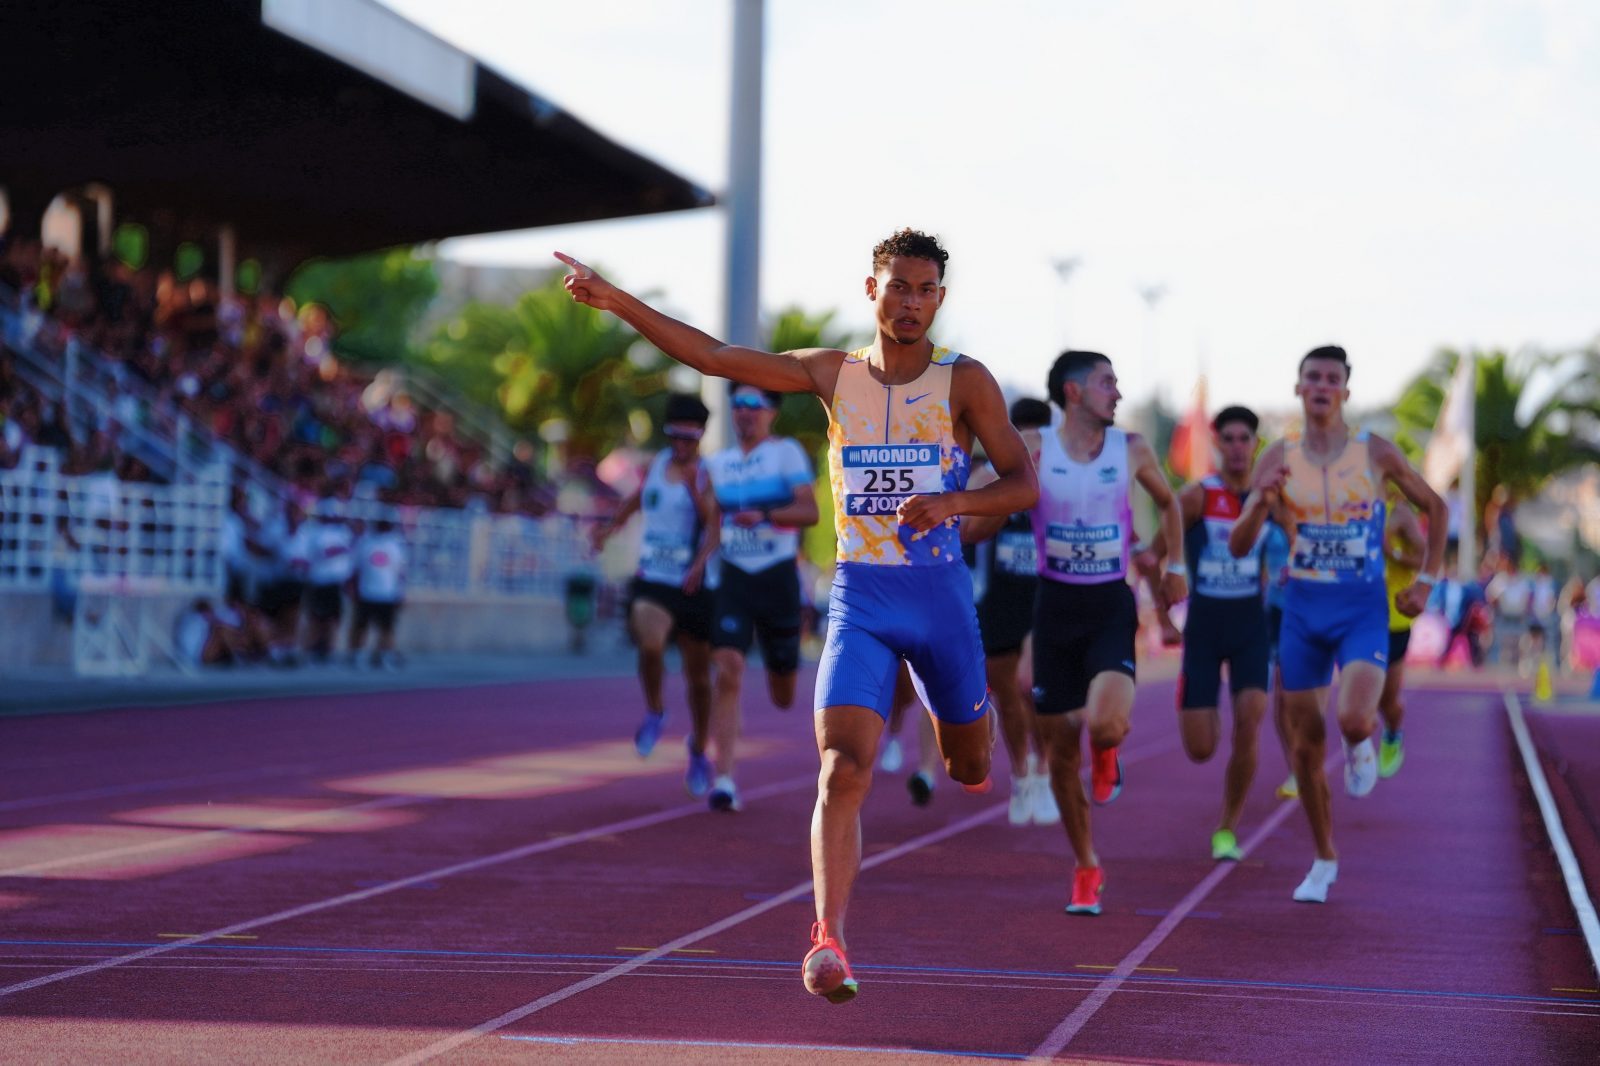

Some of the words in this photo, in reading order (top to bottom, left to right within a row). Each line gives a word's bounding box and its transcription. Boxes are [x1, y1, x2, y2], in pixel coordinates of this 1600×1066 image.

[860, 448, 931, 463] MONDO
[863, 469, 914, 492] 255
[1062, 527, 1113, 539] MONDO
[1071, 543, 1095, 560] 55
[1312, 541, 1347, 557] 256
